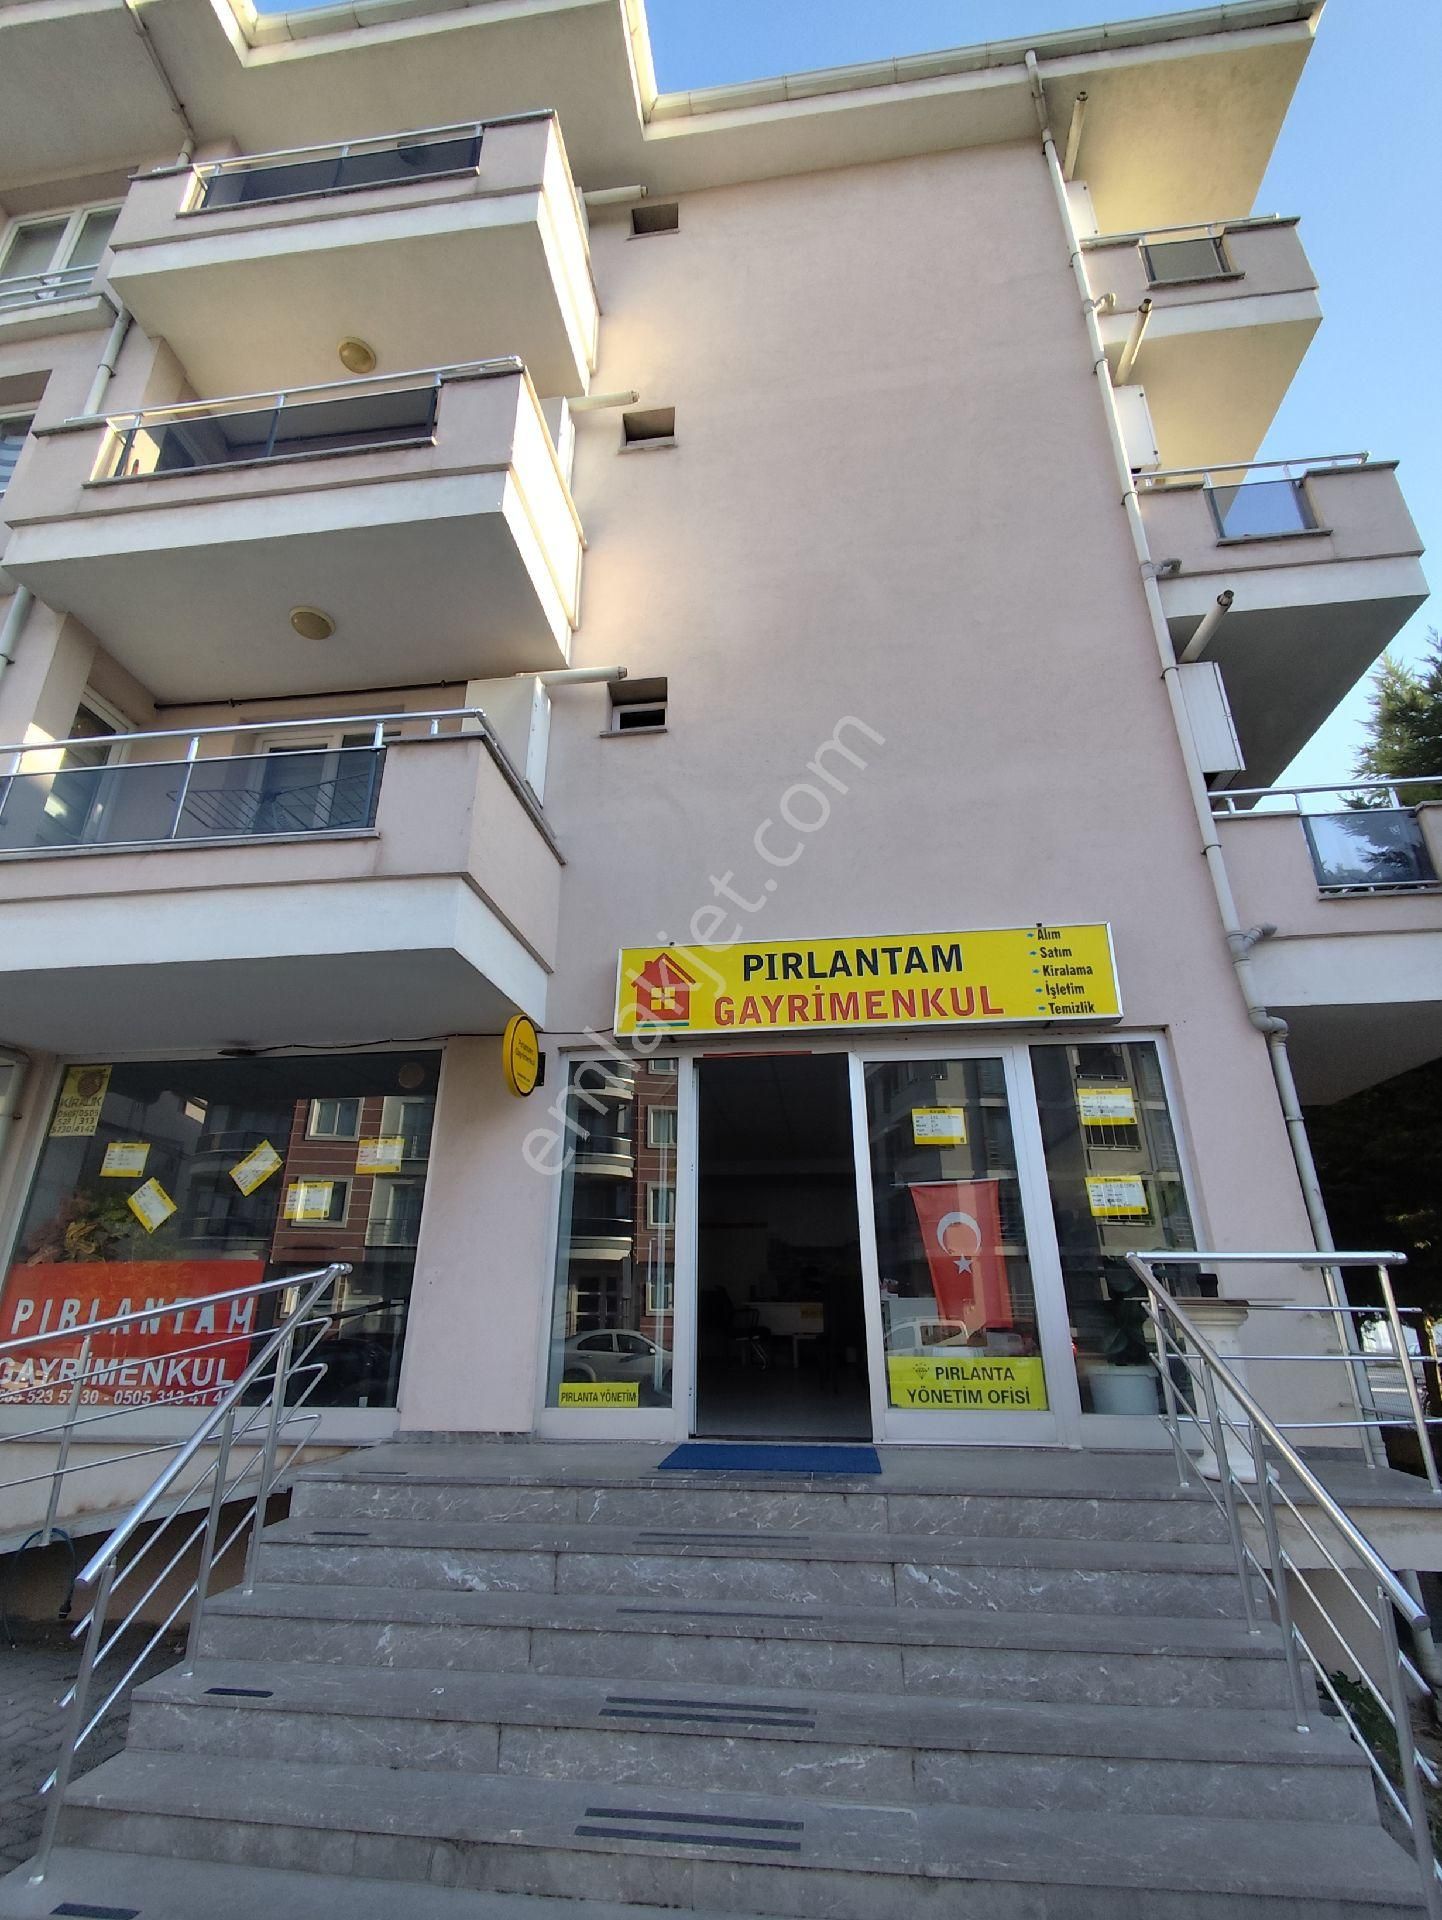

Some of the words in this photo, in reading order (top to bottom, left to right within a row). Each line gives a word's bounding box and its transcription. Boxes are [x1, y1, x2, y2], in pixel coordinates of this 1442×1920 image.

[1037, 928, 1061, 941] Alım
[1040, 946, 1072, 959] Satım
[743, 944, 963, 981] PIRLANTAM
[1042, 964, 1094, 977] Kiralama
[1045, 980, 1085, 1000] İşletim
[713, 985, 1004, 1025] GAYRİMENKUL
[1048, 1001, 1096, 1015] Temizlik
[935, 1366, 1015, 1381] PIRLANTA
[81, 1389, 99, 1405] 30
[114, 1389, 153, 1405] 0505
[561, 1391, 598, 1402] PIRLANTA
[600, 1388, 637, 1402] YÖNETİM
[907, 1385, 983, 1404] YÖNETİM
[988, 1386, 1031, 1405] OFİSİ
